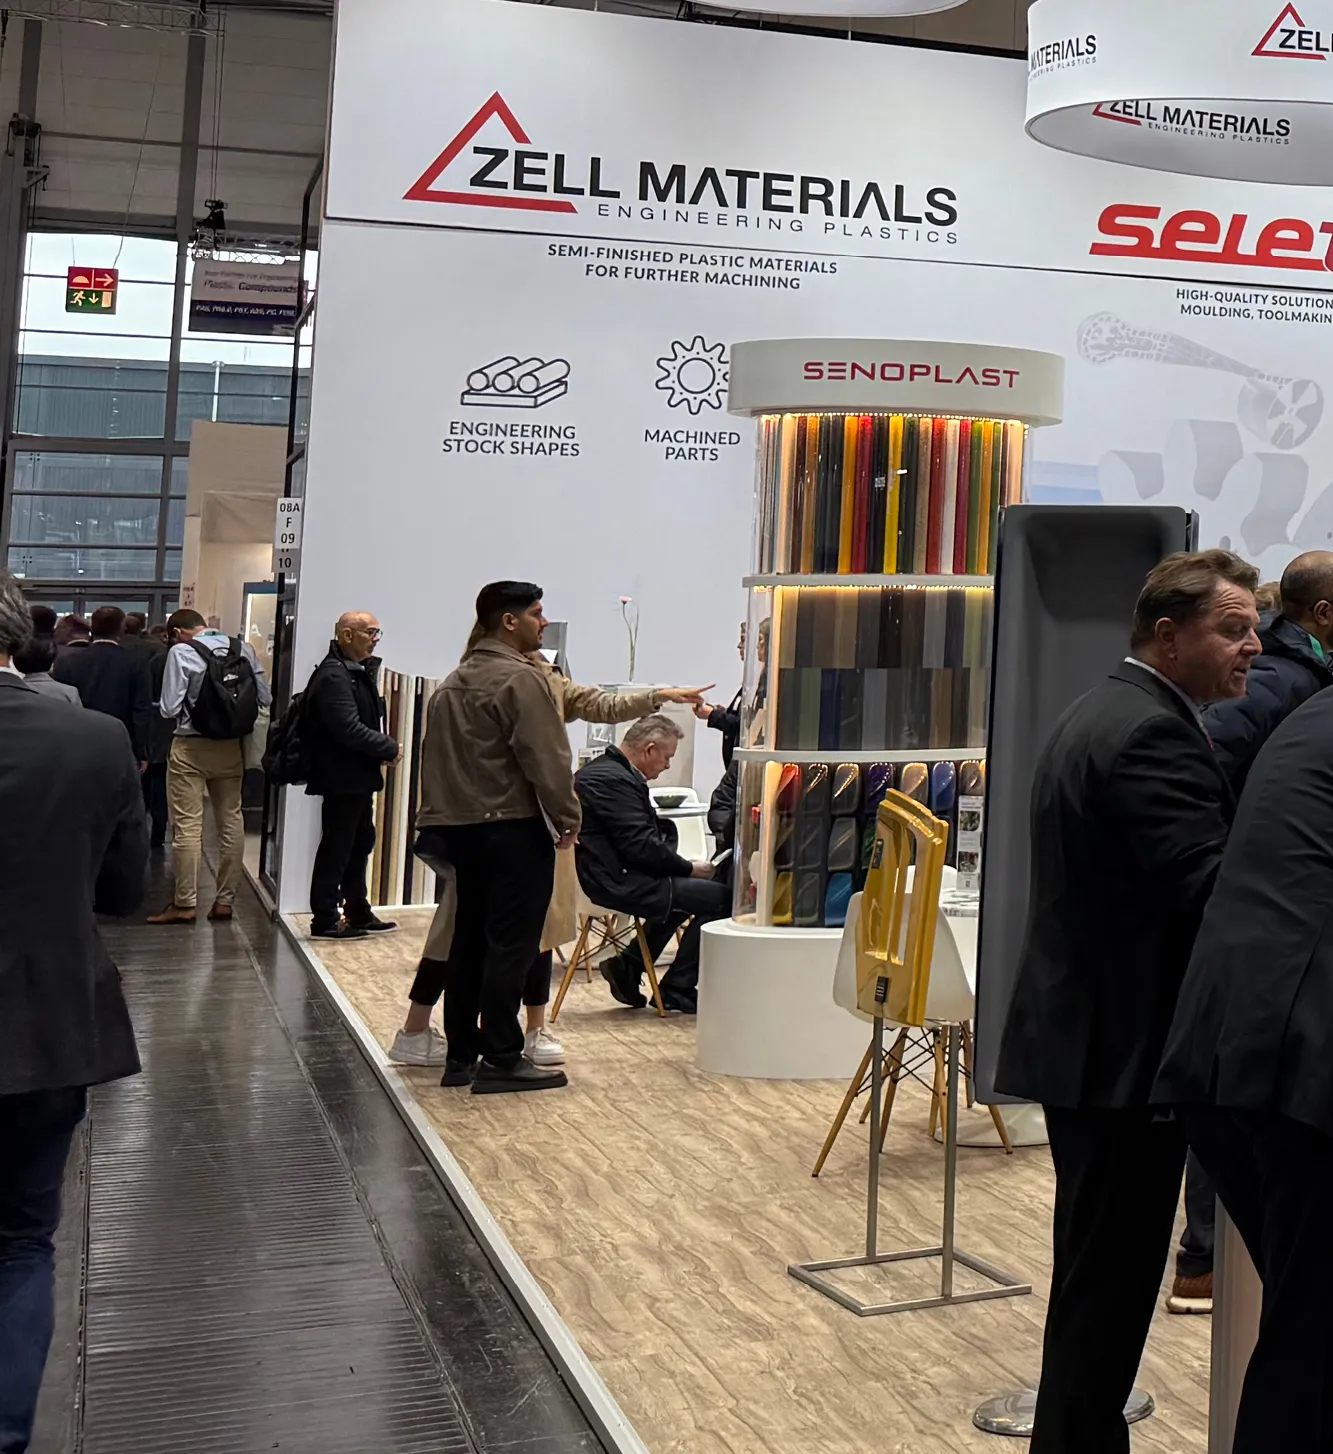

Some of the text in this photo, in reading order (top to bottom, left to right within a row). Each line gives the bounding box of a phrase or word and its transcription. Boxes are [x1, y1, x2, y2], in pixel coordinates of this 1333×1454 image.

[1163, 105, 1290, 137] MATERIALS
[1148, 121, 1290, 145] ENGINEERING PLASTICS
[468, 146, 958, 227] ZELL MATERIALS
[597, 203, 958, 244] ENGINEERING PLASTICS
[547, 243, 838, 275] SEMI-FINISHED PLASTIC MATERIALS
[585, 263, 801, 291] FOR FURTHER MACHINING
[1176, 288, 1269, 305] HIGH-QUALITY
[1180, 304, 1254, 320] MOULDING,
[803, 361, 1020, 388] SENOPLAST
[449, 421, 576, 440] ENGINEERING
[644, 429, 741, 446] MACHINED
[442, 438, 580, 457] STOCK SHAPES
[665, 446, 719, 462] PARTS
[279, 502, 300, 513] 08A
[286, 517, 292, 529] F
[280, 533, 295, 544] 09
[278, 557, 292, 569] 10
